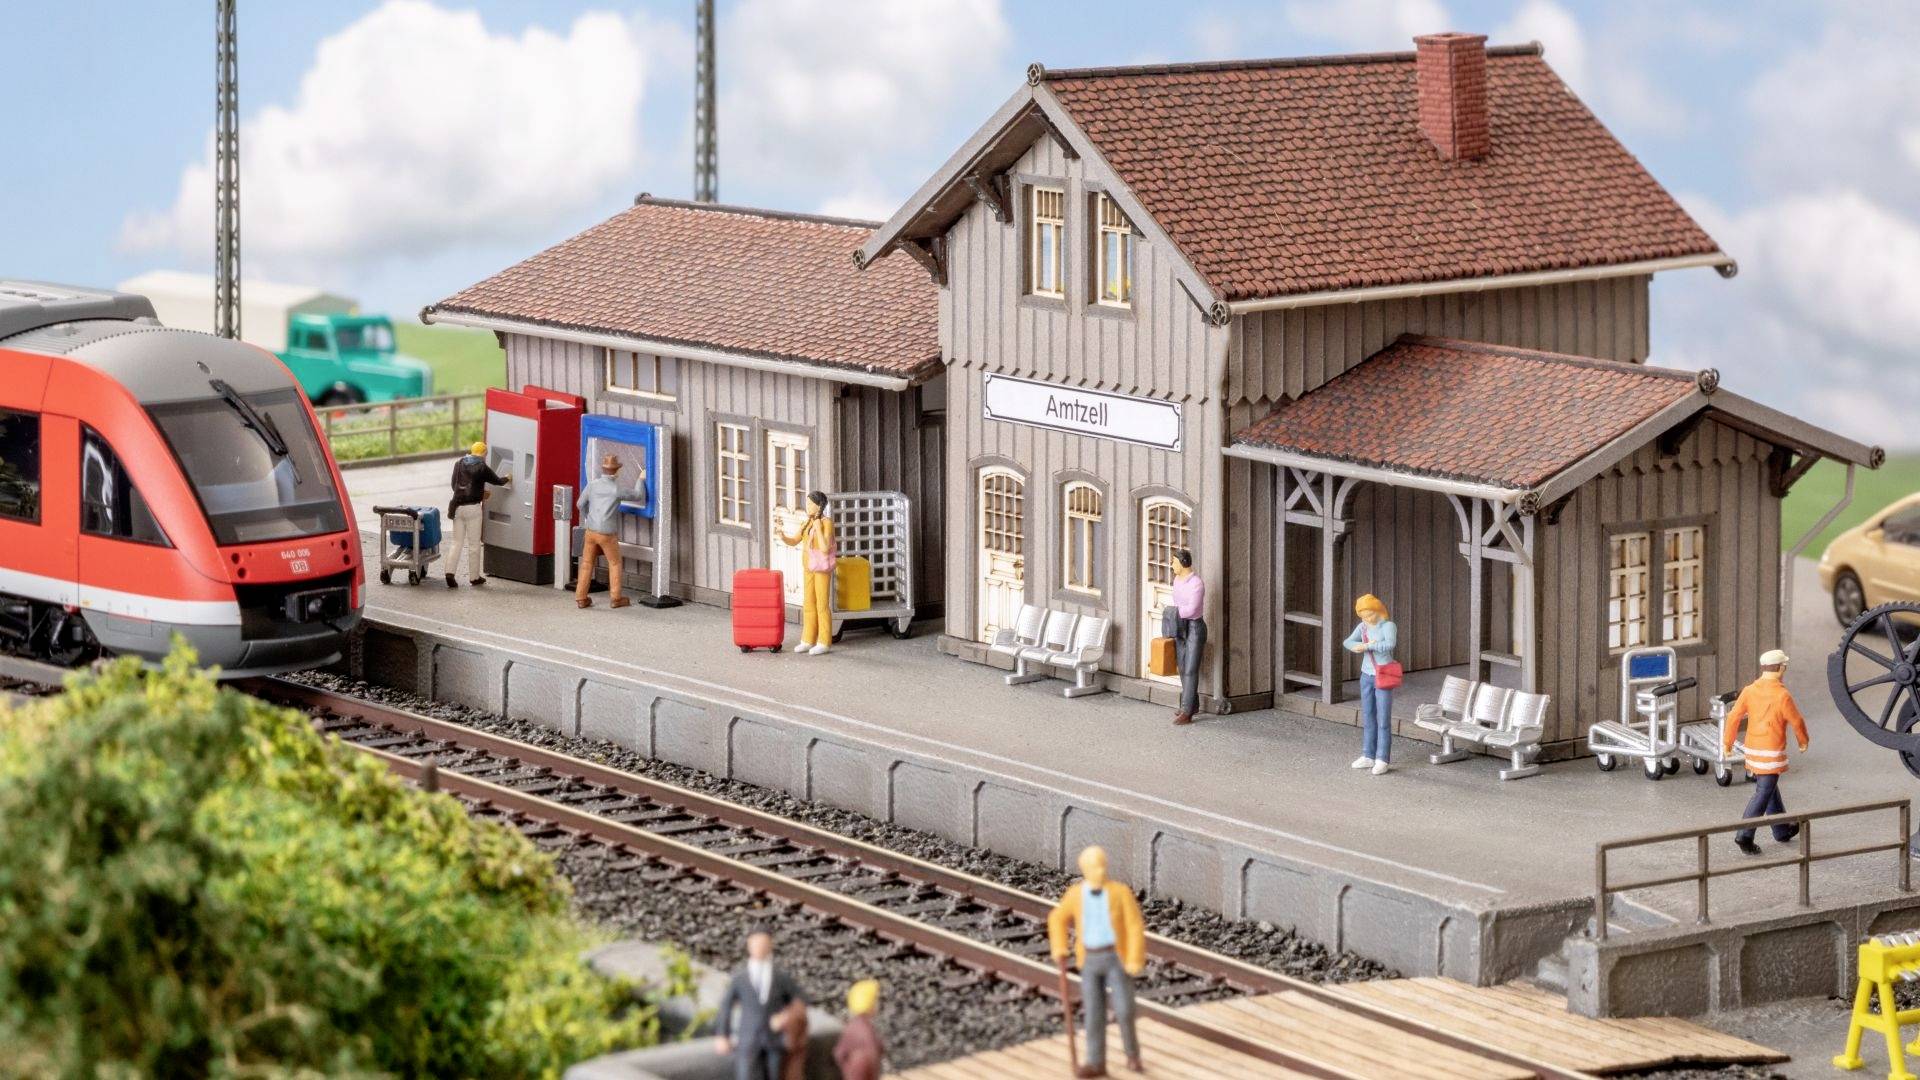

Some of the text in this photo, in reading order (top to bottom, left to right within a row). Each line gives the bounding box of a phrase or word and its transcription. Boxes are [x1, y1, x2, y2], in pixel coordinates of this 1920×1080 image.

[1046, 394, 1108, 427] Amtzell
[280, 550, 296, 560] 640
[291, 560, 308, 573] DB
